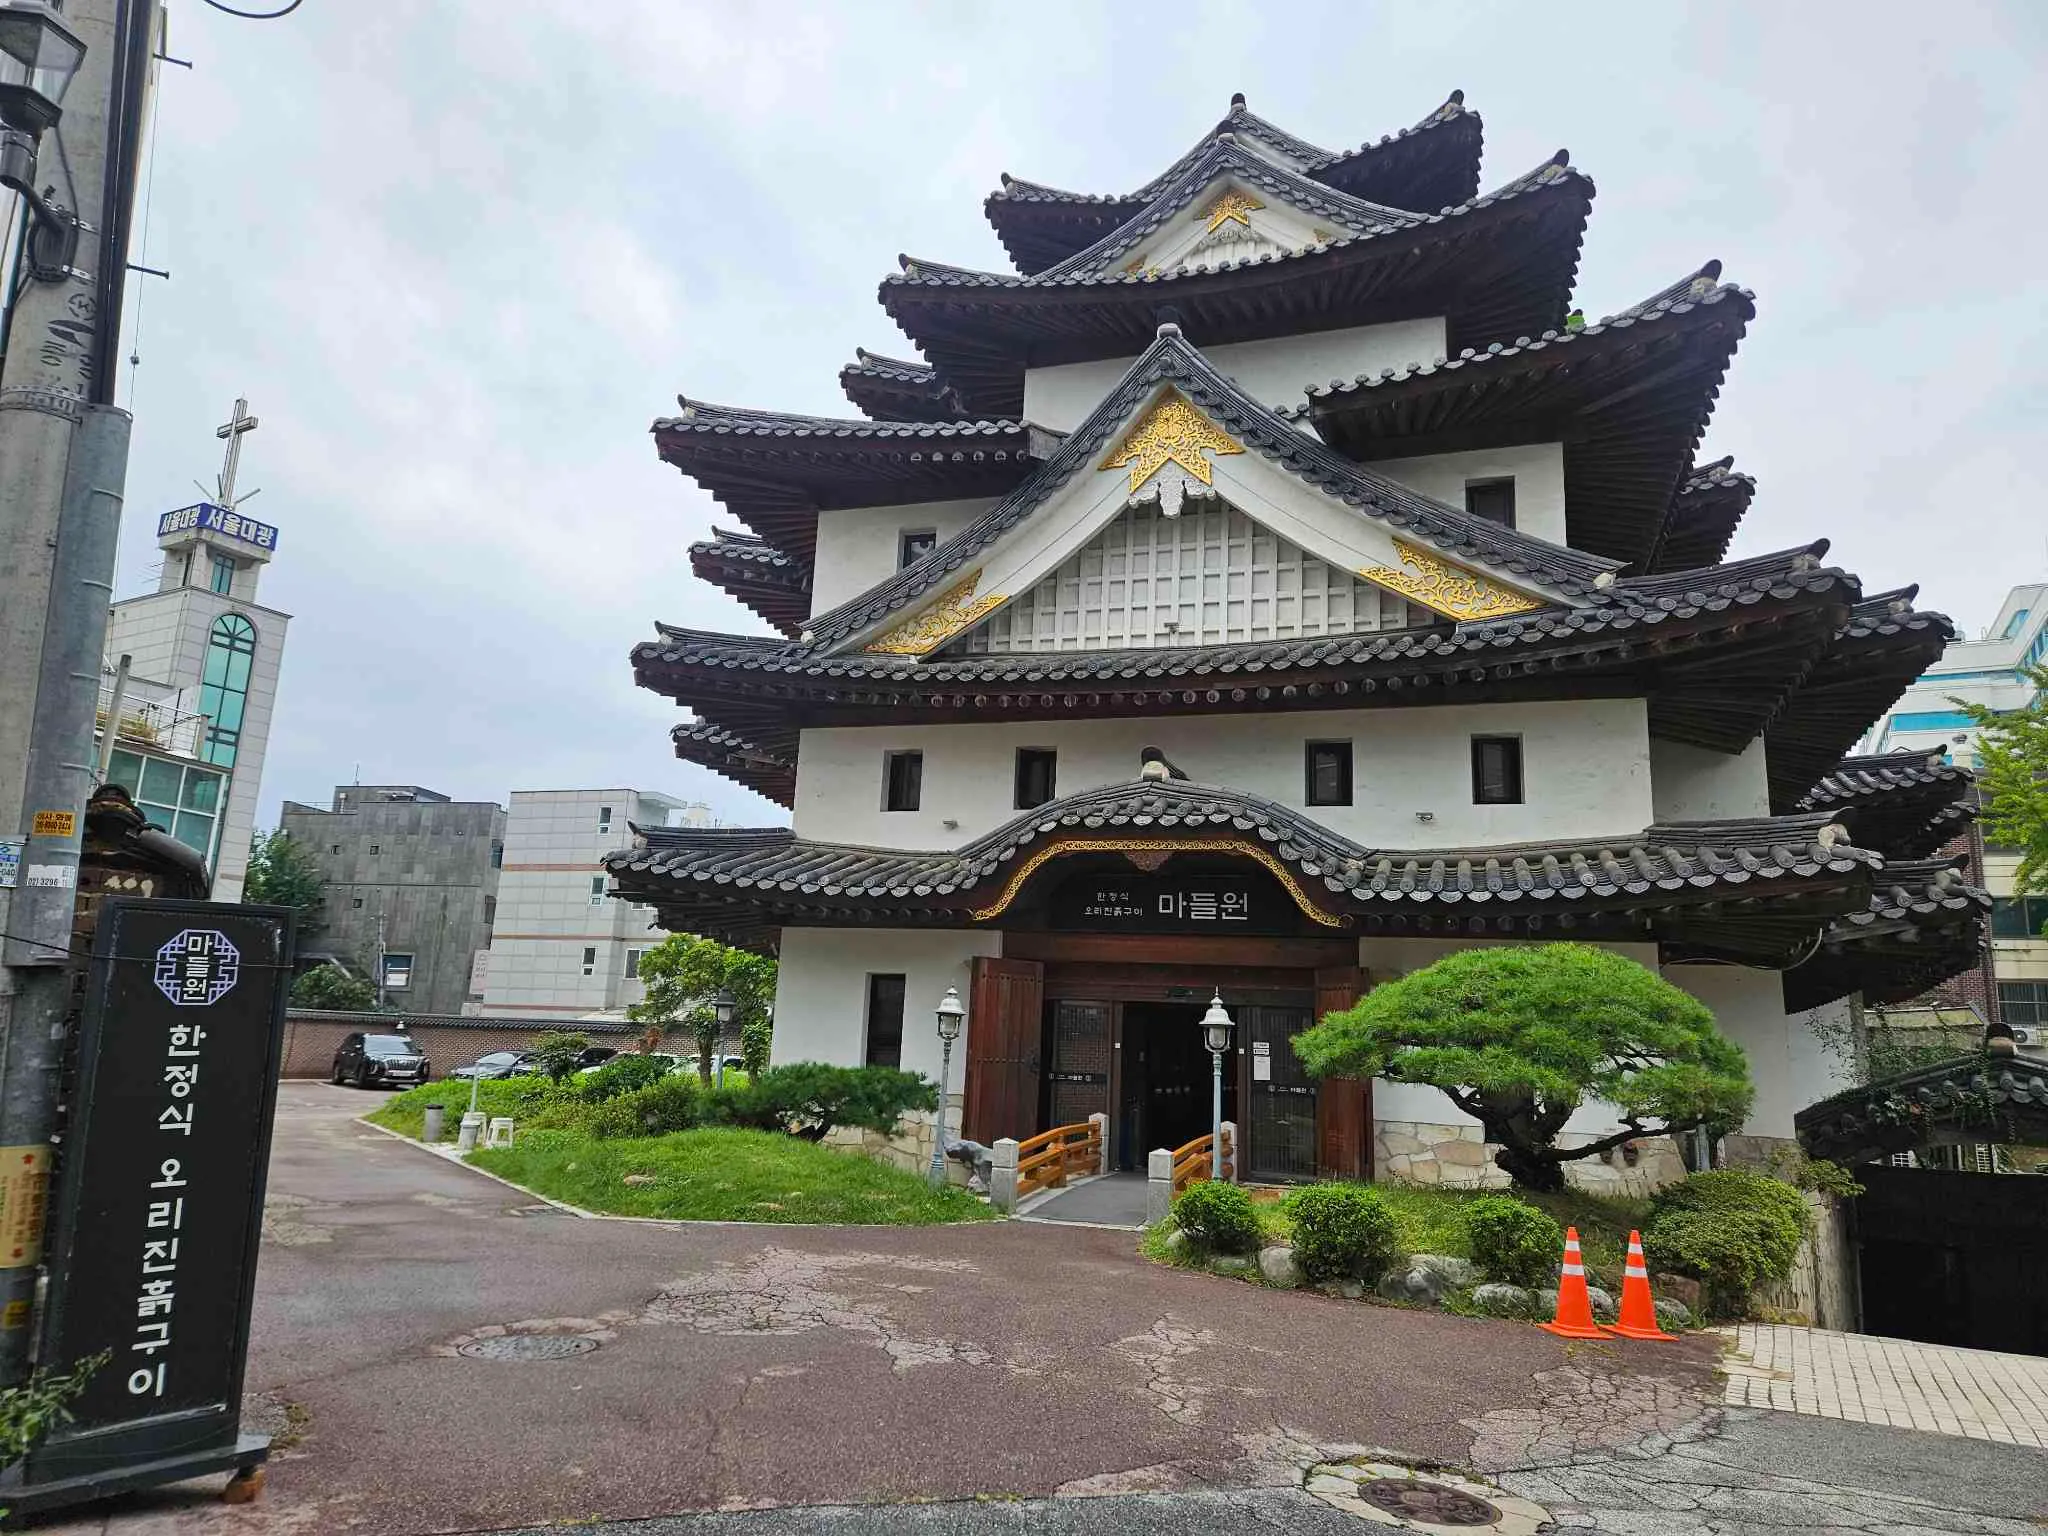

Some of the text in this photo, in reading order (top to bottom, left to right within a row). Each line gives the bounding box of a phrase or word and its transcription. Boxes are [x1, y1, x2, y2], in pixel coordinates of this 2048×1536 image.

[206, 509, 274, 546] 서울대광
[1084, 906, 1143, 916] 오리진흙구이
[1097, 892, 1128, 901] 한정식
[1158, 891, 1248, 920] 마들원
[183, 934, 213, 1000] 마들원
[128, 1024, 207, 1397] 한정식 오리진흙구이
